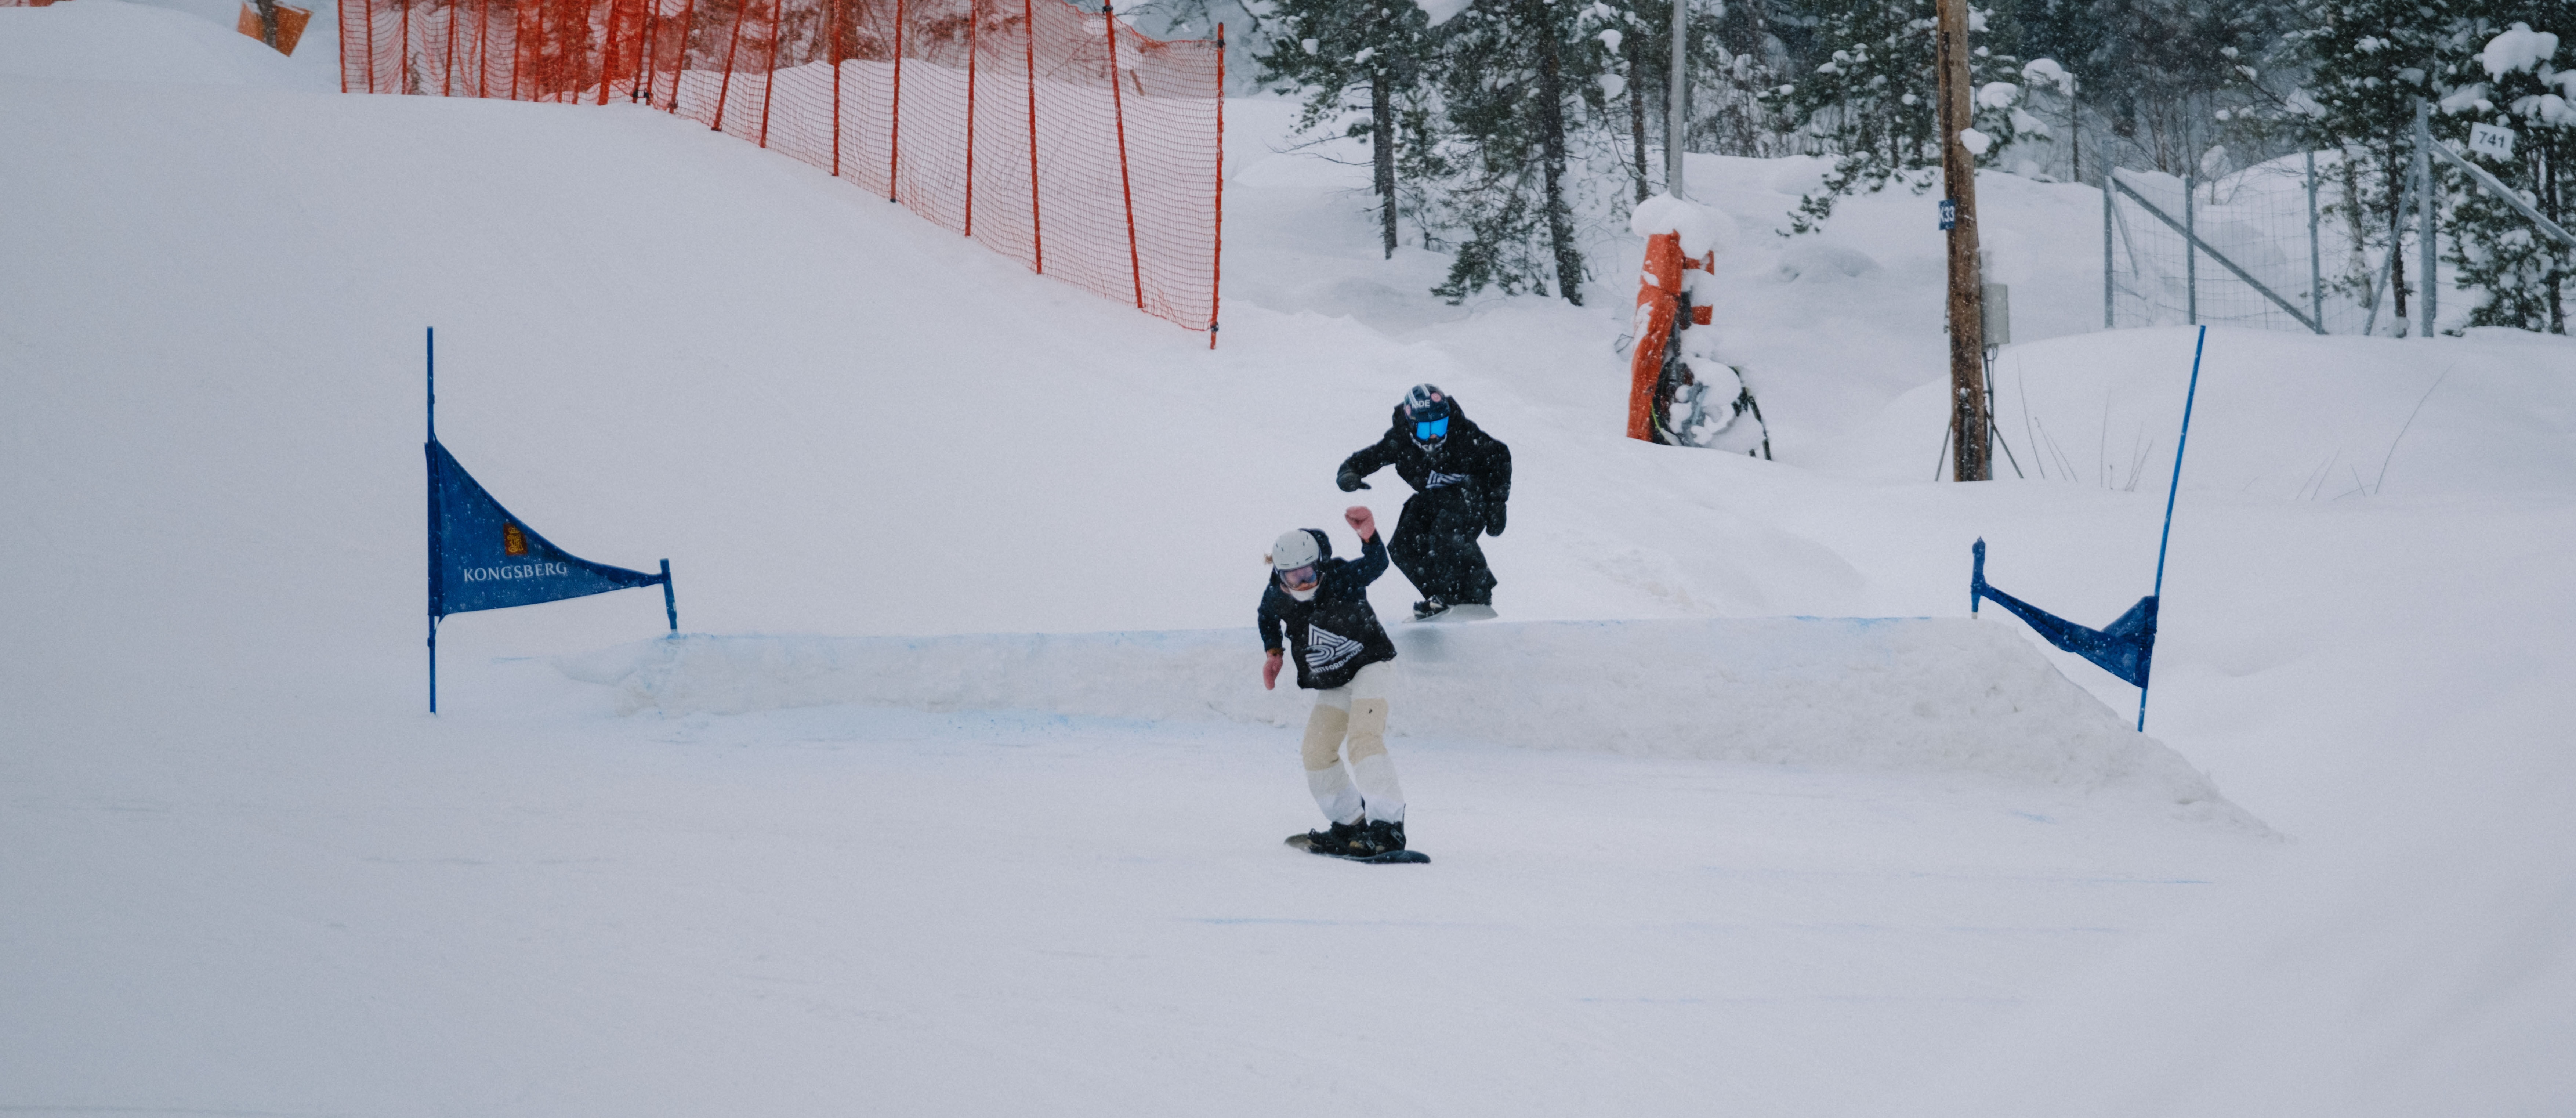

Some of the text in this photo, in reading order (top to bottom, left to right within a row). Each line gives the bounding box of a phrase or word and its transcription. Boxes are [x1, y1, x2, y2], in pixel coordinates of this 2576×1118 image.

[2479, 131, 2505, 148] 741
[1939, 206, 1954, 222] K33
[464, 562, 568, 582] KONGSBERG
